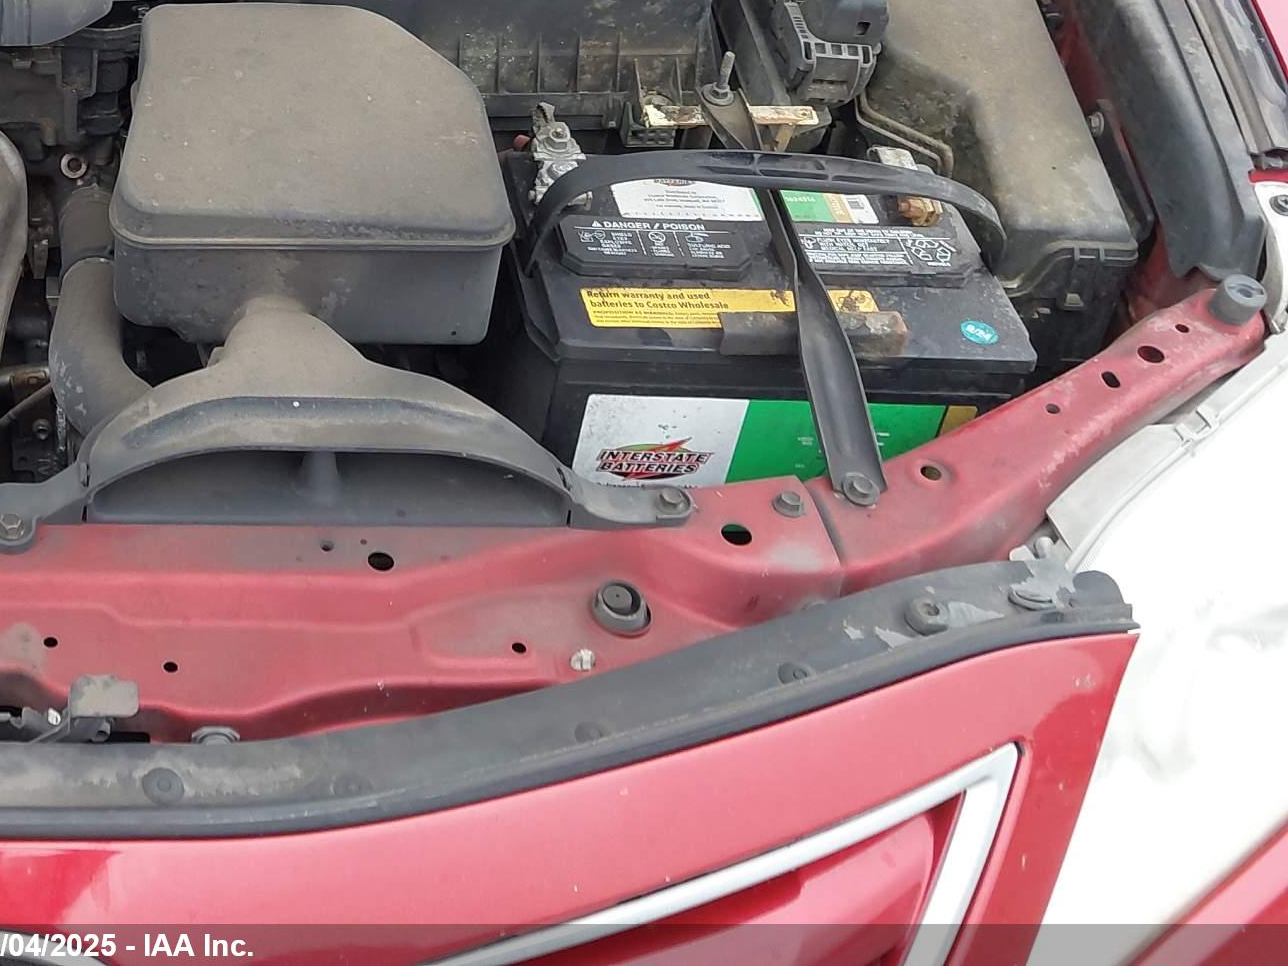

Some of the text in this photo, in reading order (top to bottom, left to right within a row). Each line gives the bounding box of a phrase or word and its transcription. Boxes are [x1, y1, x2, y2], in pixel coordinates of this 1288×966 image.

[603, 220, 650, 230] DANGER
[662, 223, 705, 231] POISON
[587, 290, 710, 301] Return warranty and used
[590, 300, 729, 310] batteries to Costco Wholesale
[598, 450, 710, 463] INTERSTATE
[598, 462, 699, 474] BATTERIES
